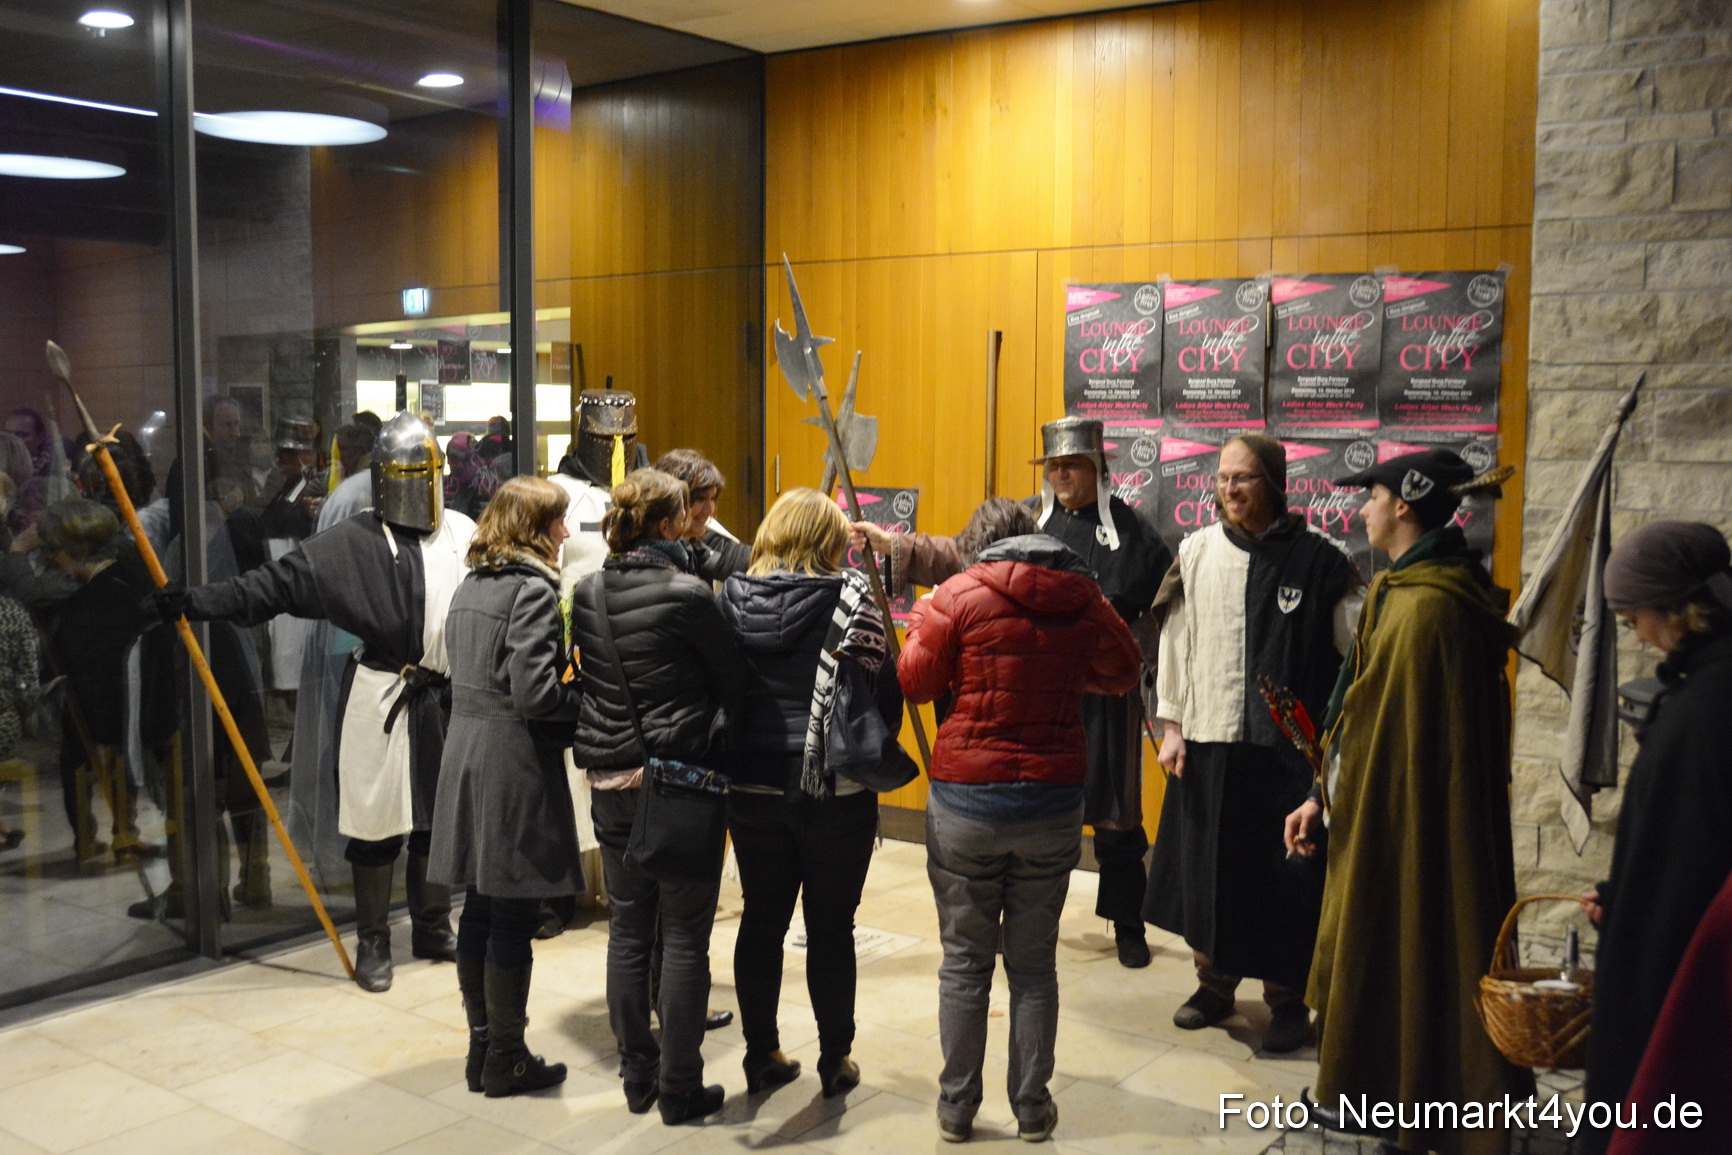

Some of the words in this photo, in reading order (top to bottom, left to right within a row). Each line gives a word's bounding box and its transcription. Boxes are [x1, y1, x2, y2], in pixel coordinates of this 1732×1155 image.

[1080, 321, 1148, 337] LOUNGE
[1179, 319, 1250, 335] LOUNGE
[1289, 315, 1366, 331] LOUNGE
[1402, 315, 1483, 331] LOUNGE
[1079, 348, 1145, 373] CITY
[1178, 346, 1247, 372] CITY
[1287, 344, 1362, 370] CITY
[1400, 346, 1479, 371] CITY
[1345, 402, 1364, 410] Party
[1460, 405, 1482, 413] Party
[1112, 472, 1145, 487] NGE
[1177, 475, 1214, 489] LOU
